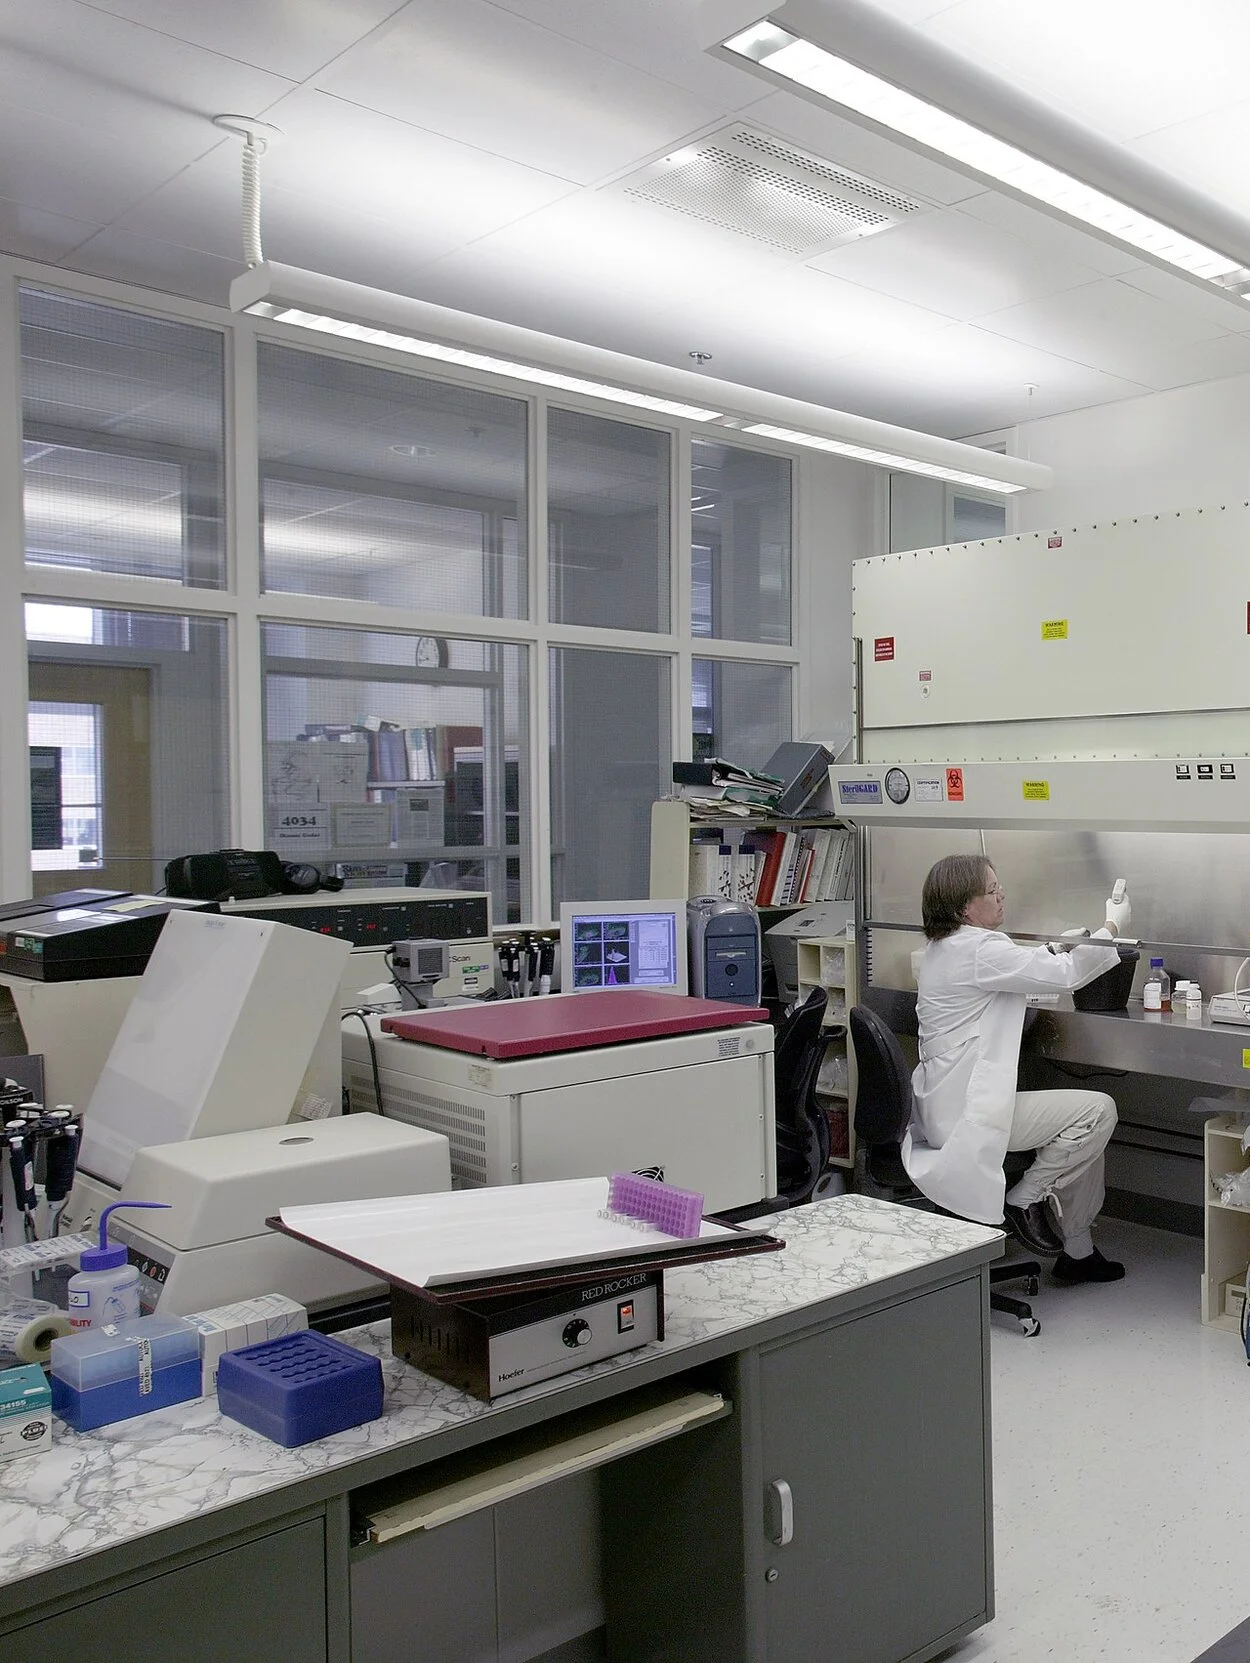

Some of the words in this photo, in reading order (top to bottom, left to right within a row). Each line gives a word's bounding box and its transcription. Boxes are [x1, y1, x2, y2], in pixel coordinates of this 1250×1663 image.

[842, 784, 879, 794] SterilGARD
[281, 816, 317, 826] 4034
[582, 1286, 604, 1301] RED
[604, 1272, 647, 1294] ROCKER
[498, 1367, 525, 1382] Hoefer
